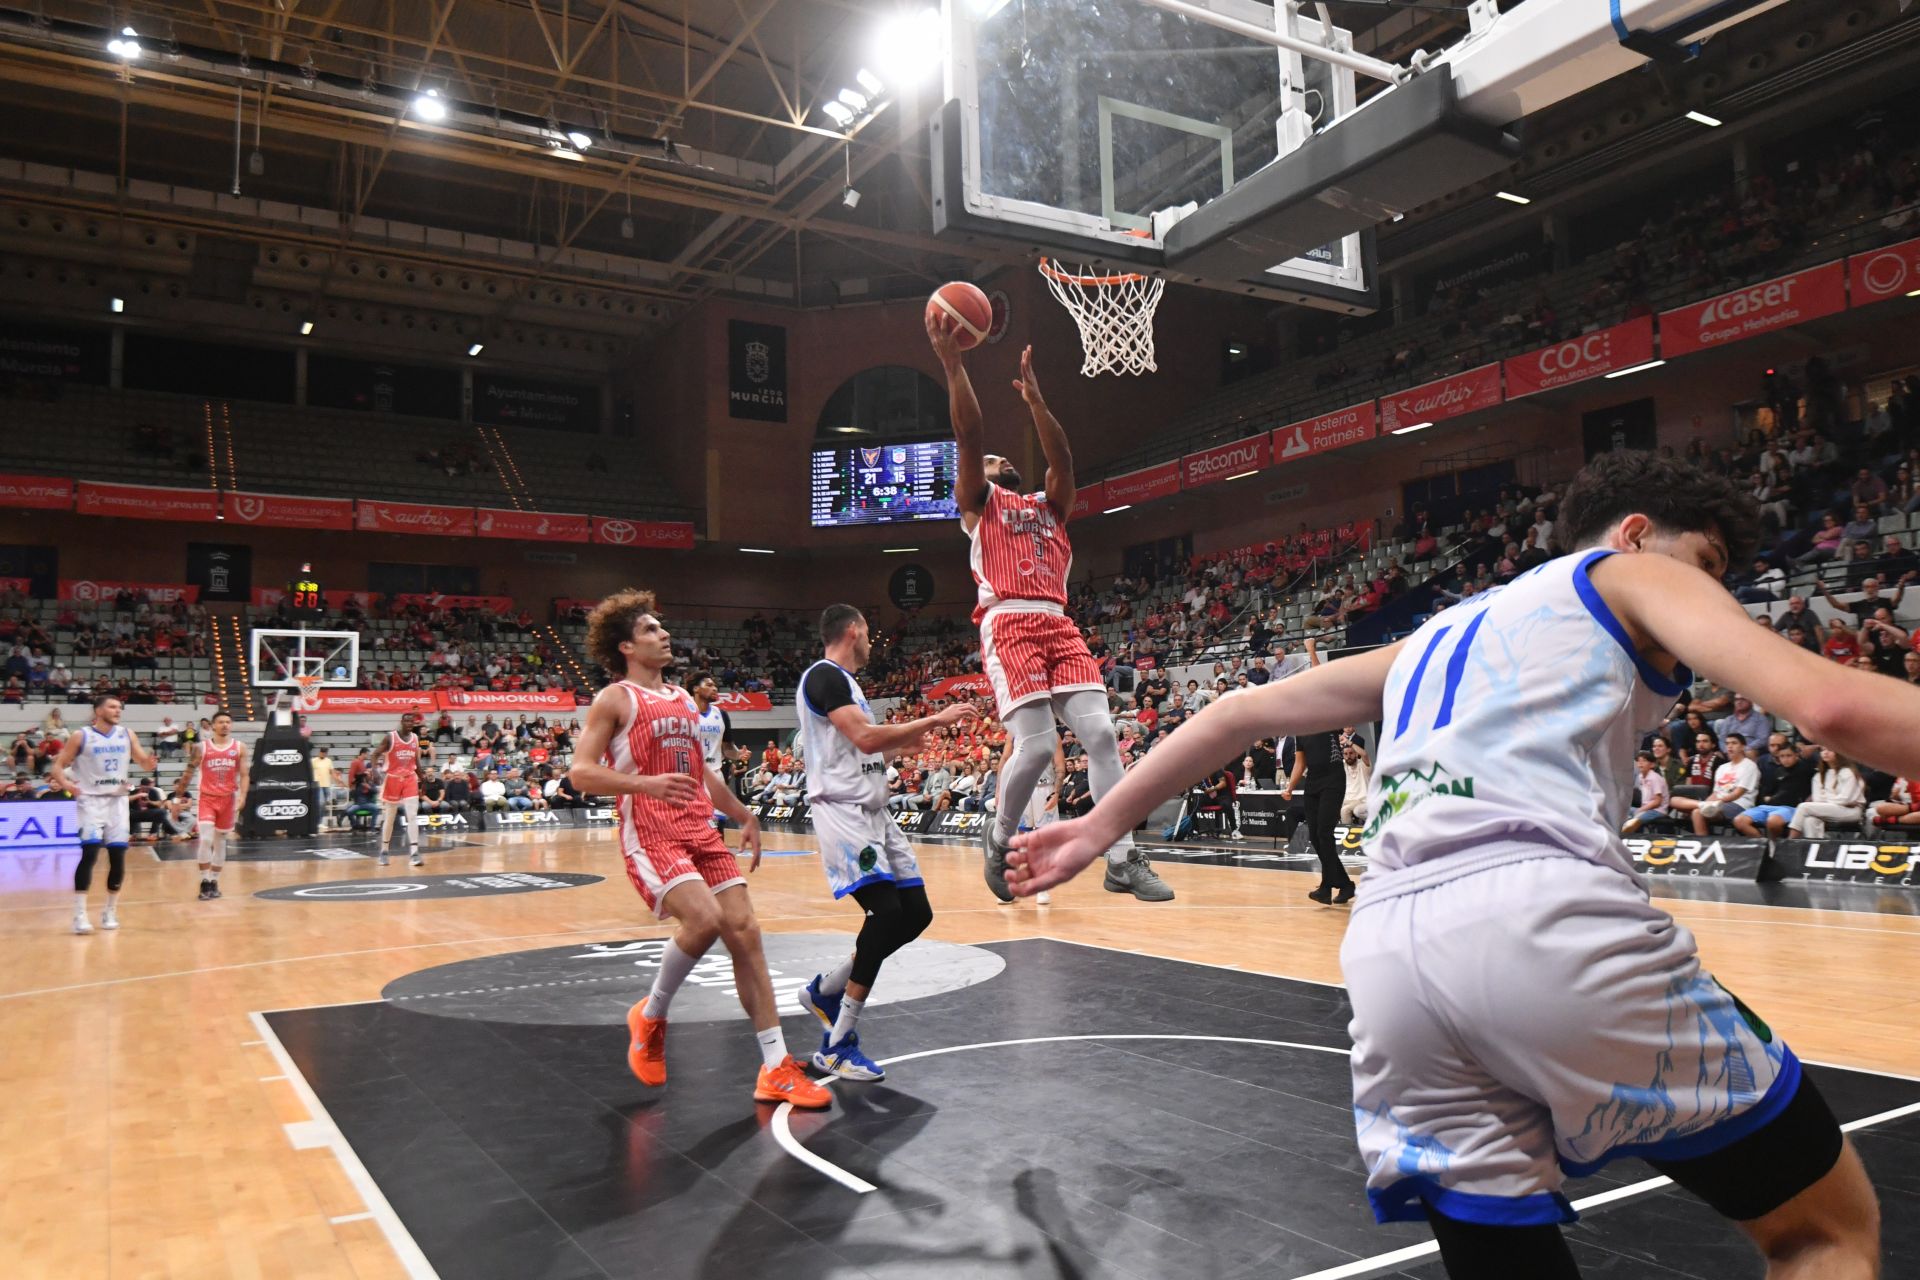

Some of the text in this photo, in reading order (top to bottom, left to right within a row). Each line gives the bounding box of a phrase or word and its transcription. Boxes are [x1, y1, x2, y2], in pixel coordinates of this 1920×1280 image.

[1717, 279, 1797, 320] caser
[1700, 309, 1799, 342] Grupo Helvetia
[0, 338, 81, 357] tamiento
[487, 384, 579, 406] Ayuntamiento
[731, 391, 784, 406] MURCIA
[1313, 412, 1358, 434] Asterra
[1313, 426, 1365, 449] Partners
[1189, 444, 1261, 474] setcomur
[865, 473, 877, 485] 21
[893, 471, 906, 483] 15
[873, 486, 898, 497] 6:38
[1394, 606, 1491, 742] 11
[327, 696, 432, 706] IBERIA VITAE
[473, 694, 559, 704] INMOKING
[105, 758, 119, 771] 23
[208, 758, 236, 768] UCAM
[496, 811, 559, 824] LIBERA
[767, 806, 795, 819] LIBERA
[1242, 810, 1275, 819] Ayuntamiento
[941, 813, 987, 828] LIBERA
[1249, 818, 1268, 826] Murcia
